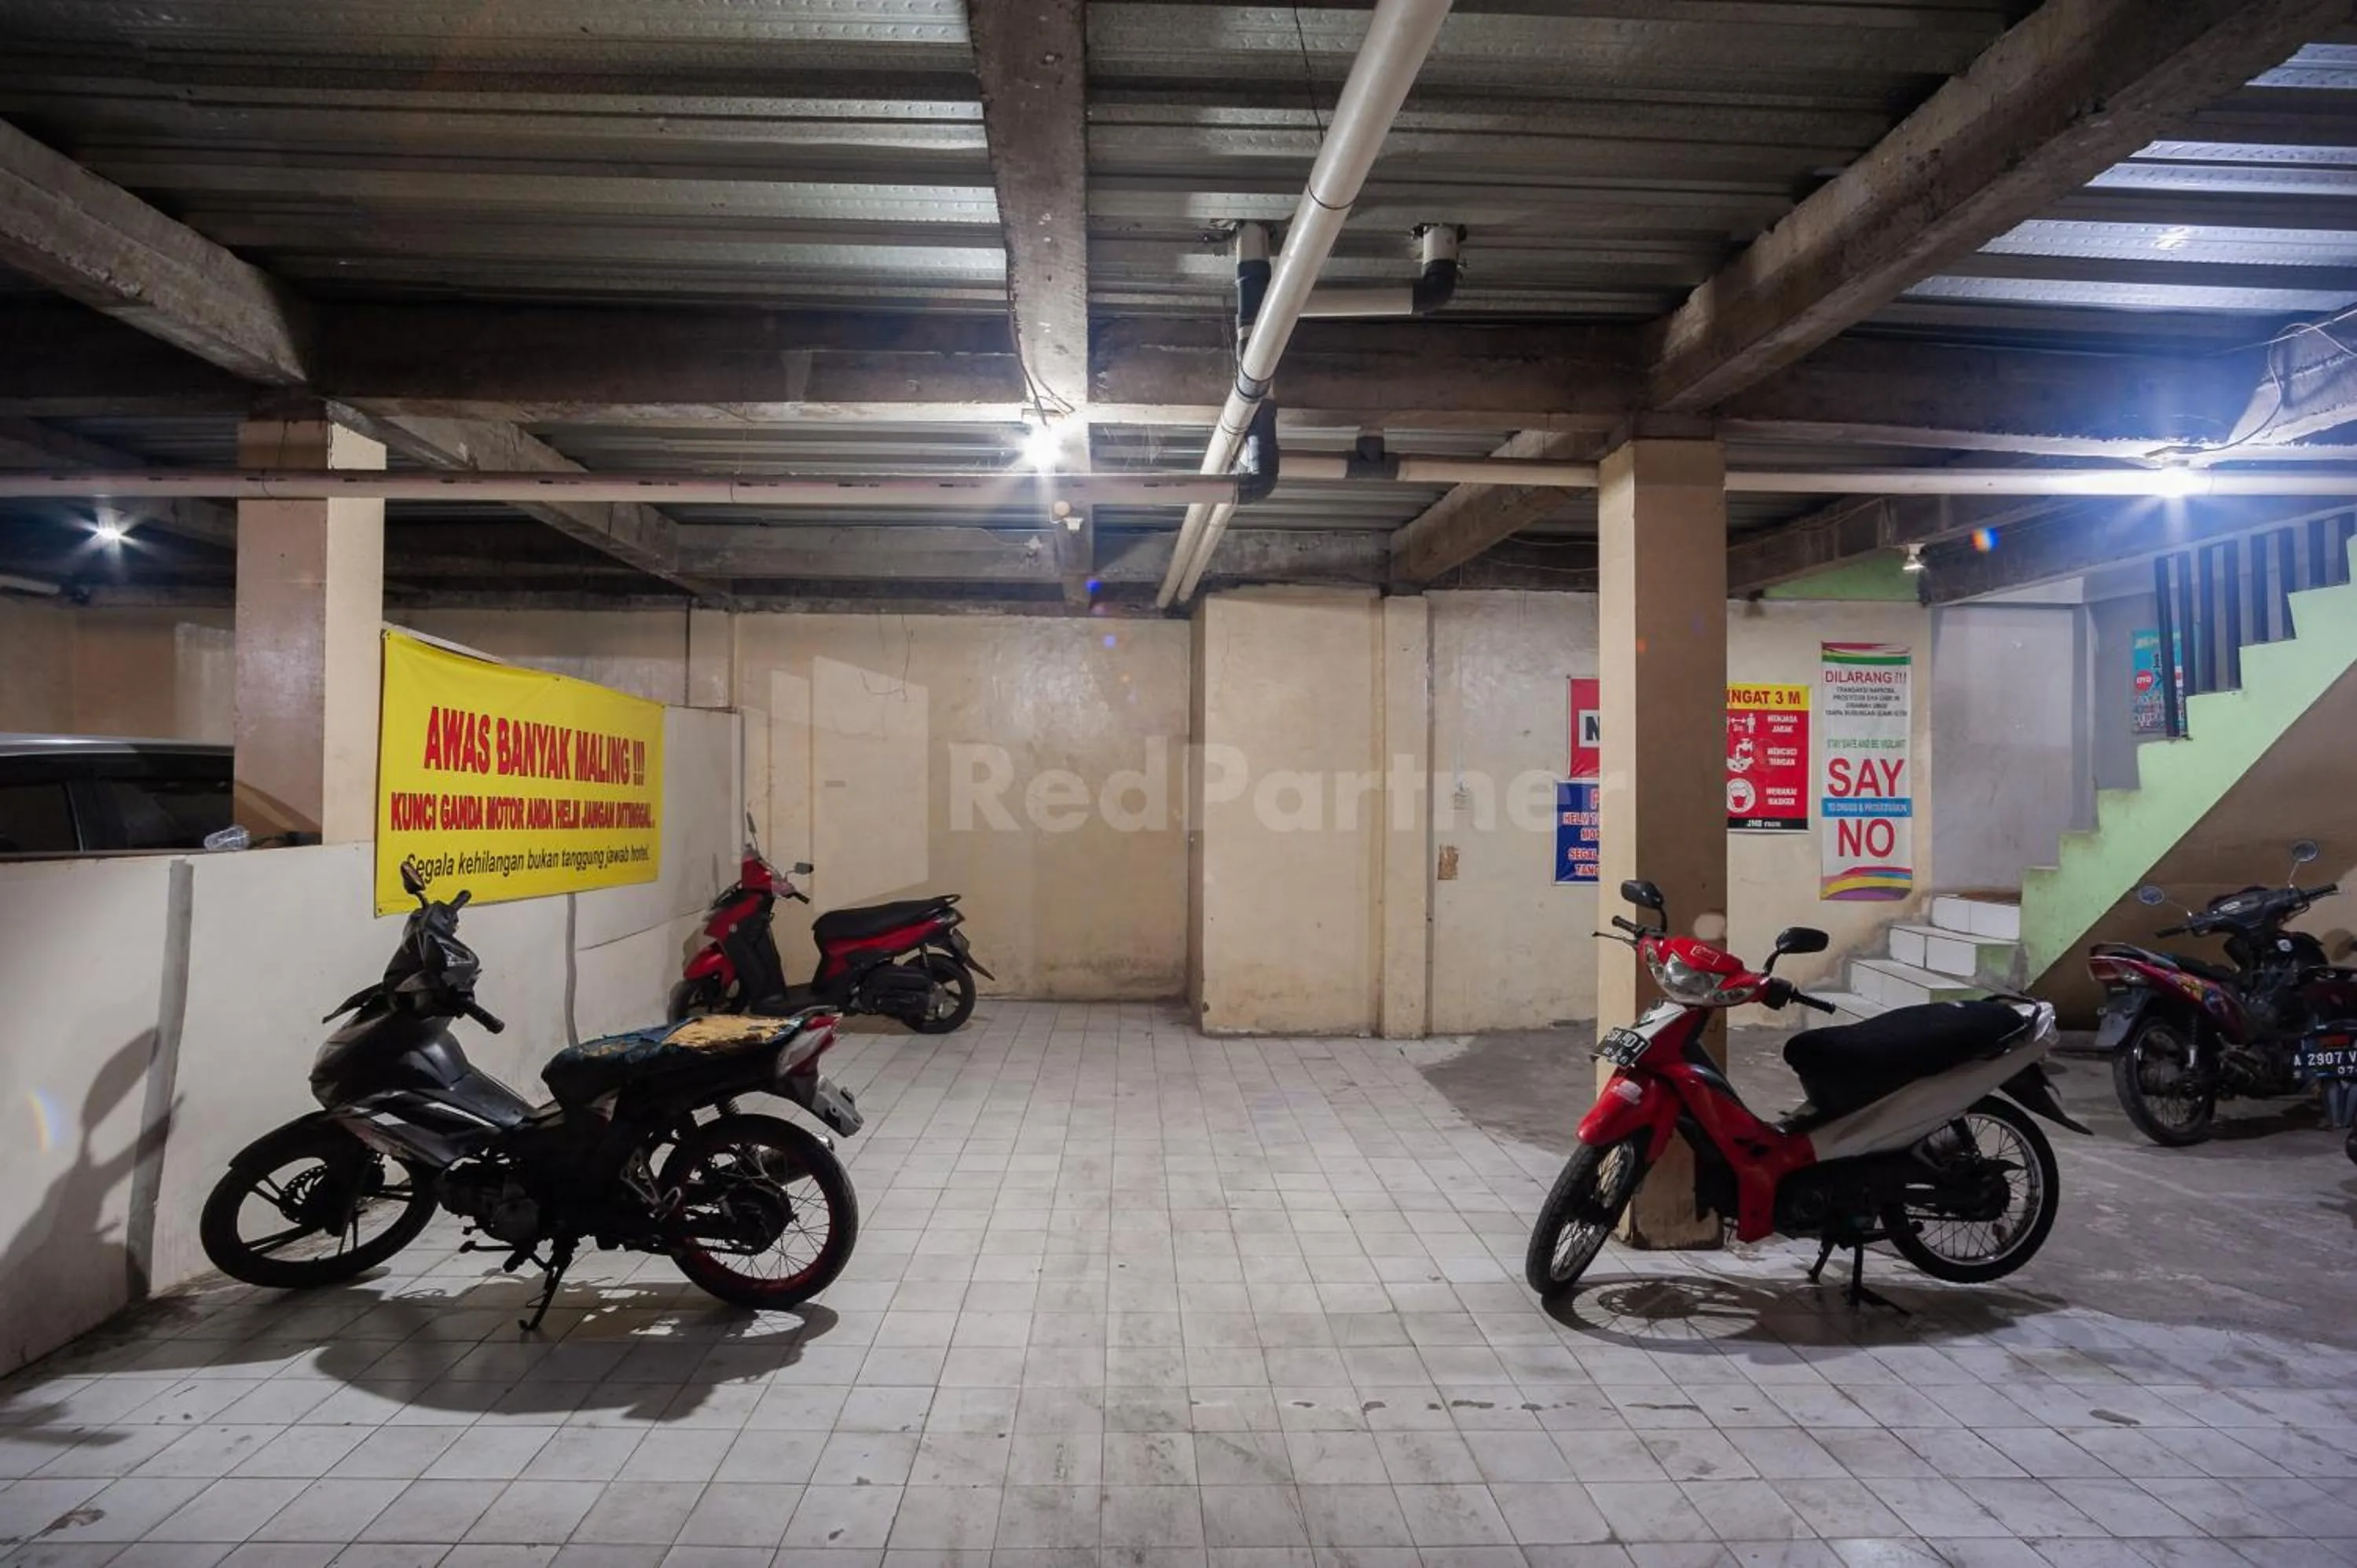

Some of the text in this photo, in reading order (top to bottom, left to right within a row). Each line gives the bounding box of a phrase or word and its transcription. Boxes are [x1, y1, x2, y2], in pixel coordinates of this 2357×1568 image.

[1825, 670, 1893, 683] DILARANG
[1775, 691, 1783, 705] 3
[1788, 691, 1801, 705] M
[423, 705, 491, 775] AWAS
[497, 717, 572, 781] BANYAK
[574, 730, 630, 785] MALING
[1827, 757, 1905, 797] SAY
[390, 792, 436, 831] KUNCI
[441, 793, 483, 830] GANDA
[486, 796, 525, 830] MOTOR
[526, 797, 554, 830] ANDA
[1838, 818, 1895, 858] NO
[405, 853, 454, 884] Segala
[458, 851, 524, 877] kehilangan
[527, 846, 559, 869] bukan
[562, 848, 604, 873] tanggung
[603, 844, 629, 867] jawab
[2293, 1053, 2301, 1066] A
[2308, 1052, 2343, 1066] 2907
